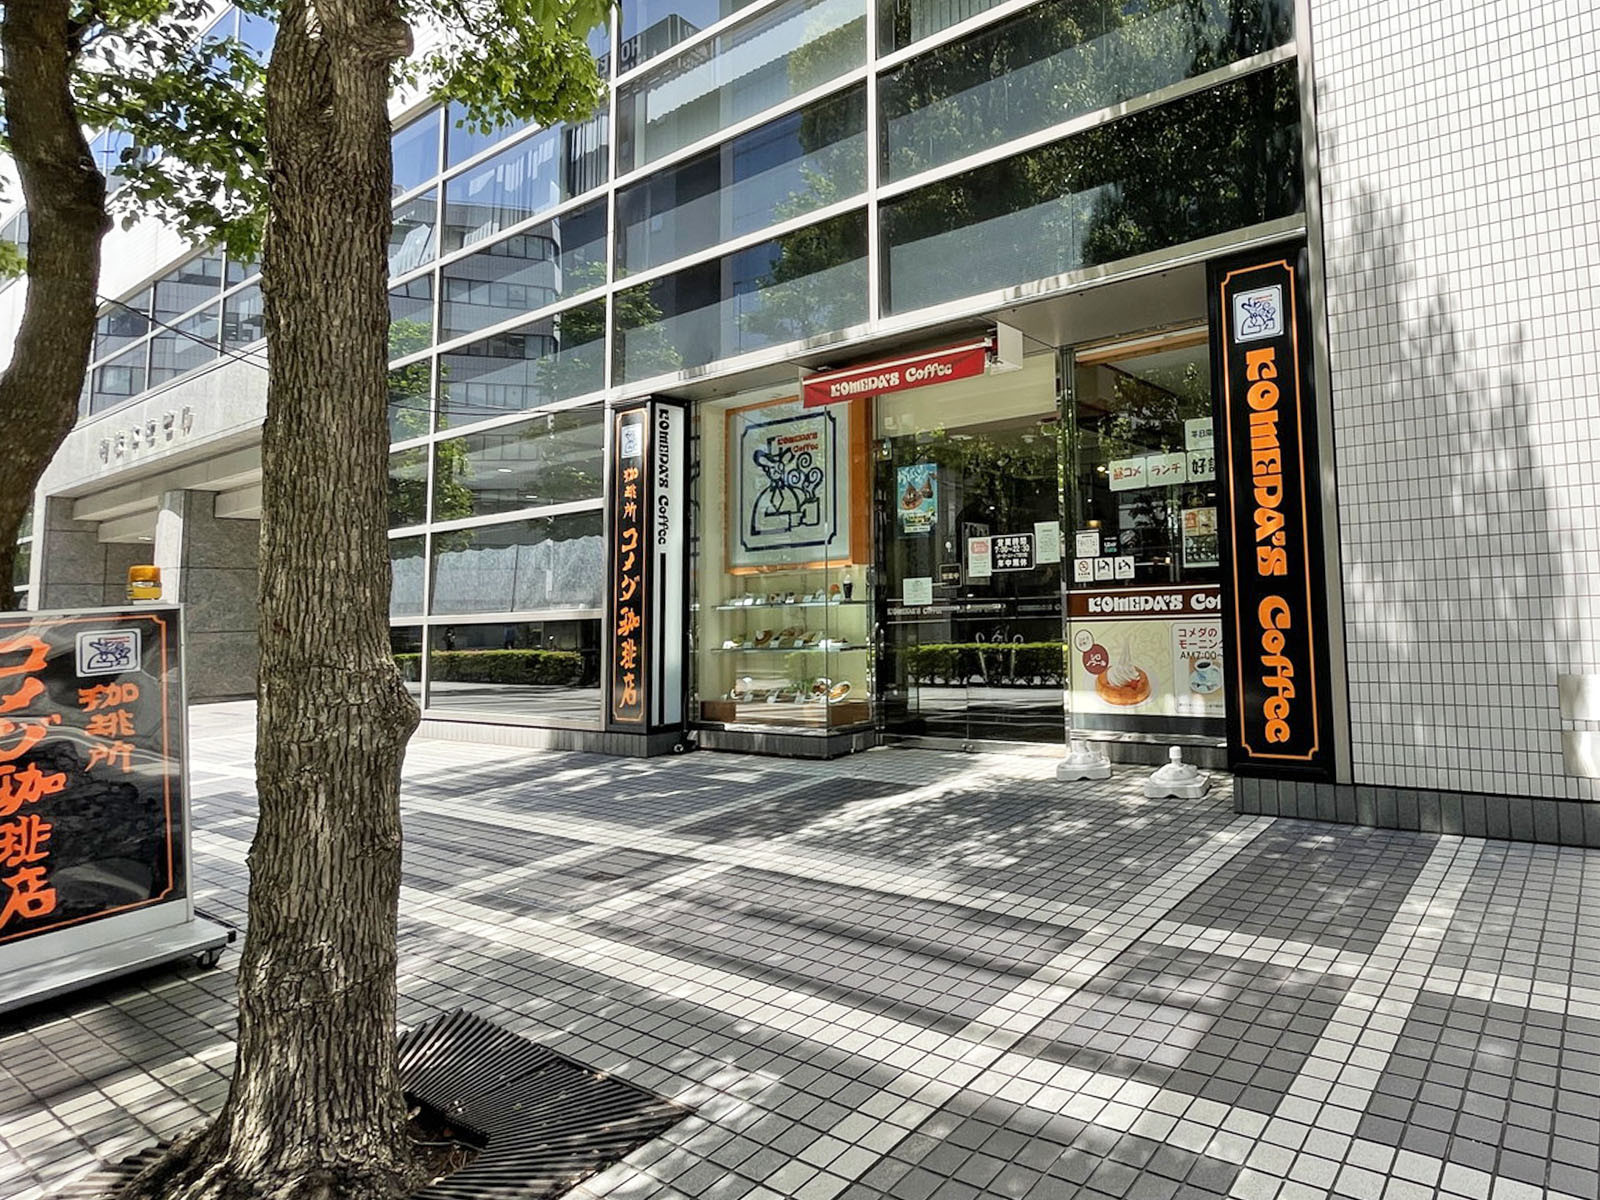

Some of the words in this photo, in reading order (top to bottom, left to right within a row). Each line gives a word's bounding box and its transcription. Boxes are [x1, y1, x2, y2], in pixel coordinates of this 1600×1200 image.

[830, 371, 900, 398] KOMEDA'S
[905, 362, 952, 384] Coffee
[658, 408, 670, 489] KOMEDA'S
[1245, 346, 1288, 577] KOMEDA'S
[657, 494, 669, 545] Coffee
[1088, 594, 1183, 613] KOMEDA'S
[1178, 627, 1218, 639] コメダの
[1257, 594, 1295, 745] Coffee
[78, 682, 140, 773] 珈琲所
